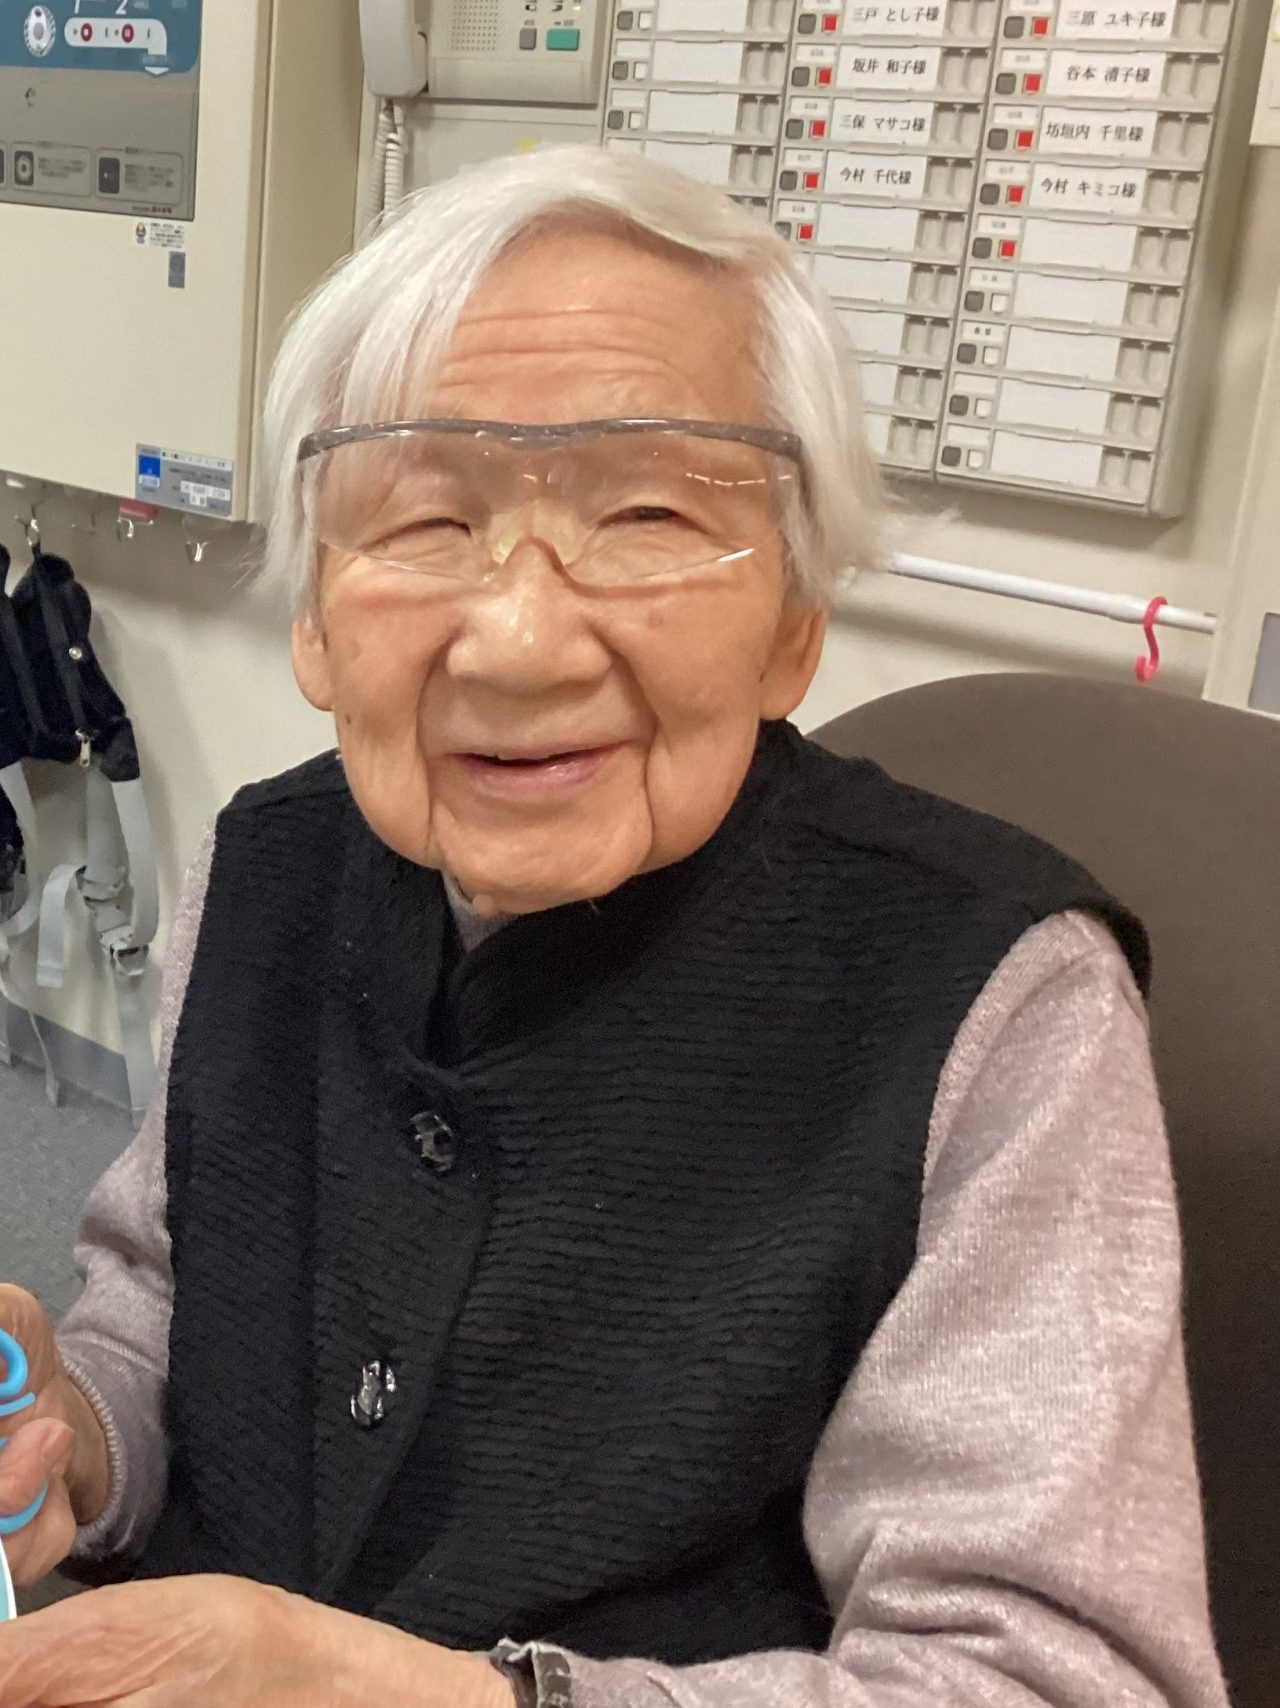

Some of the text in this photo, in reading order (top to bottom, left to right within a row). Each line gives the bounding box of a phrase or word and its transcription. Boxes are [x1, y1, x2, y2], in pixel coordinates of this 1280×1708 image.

[886, 7, 940, 22] とし子様
[852, 58, 927, 75] 坂井 和子様
[1066, 66, 1096, 81] 谷本
[873, 116, 926, 132] マサコ様
[840, 167, 913, 185] 今村 千代様
[1041, 177, 1137, 198] 今村 キミコ様
